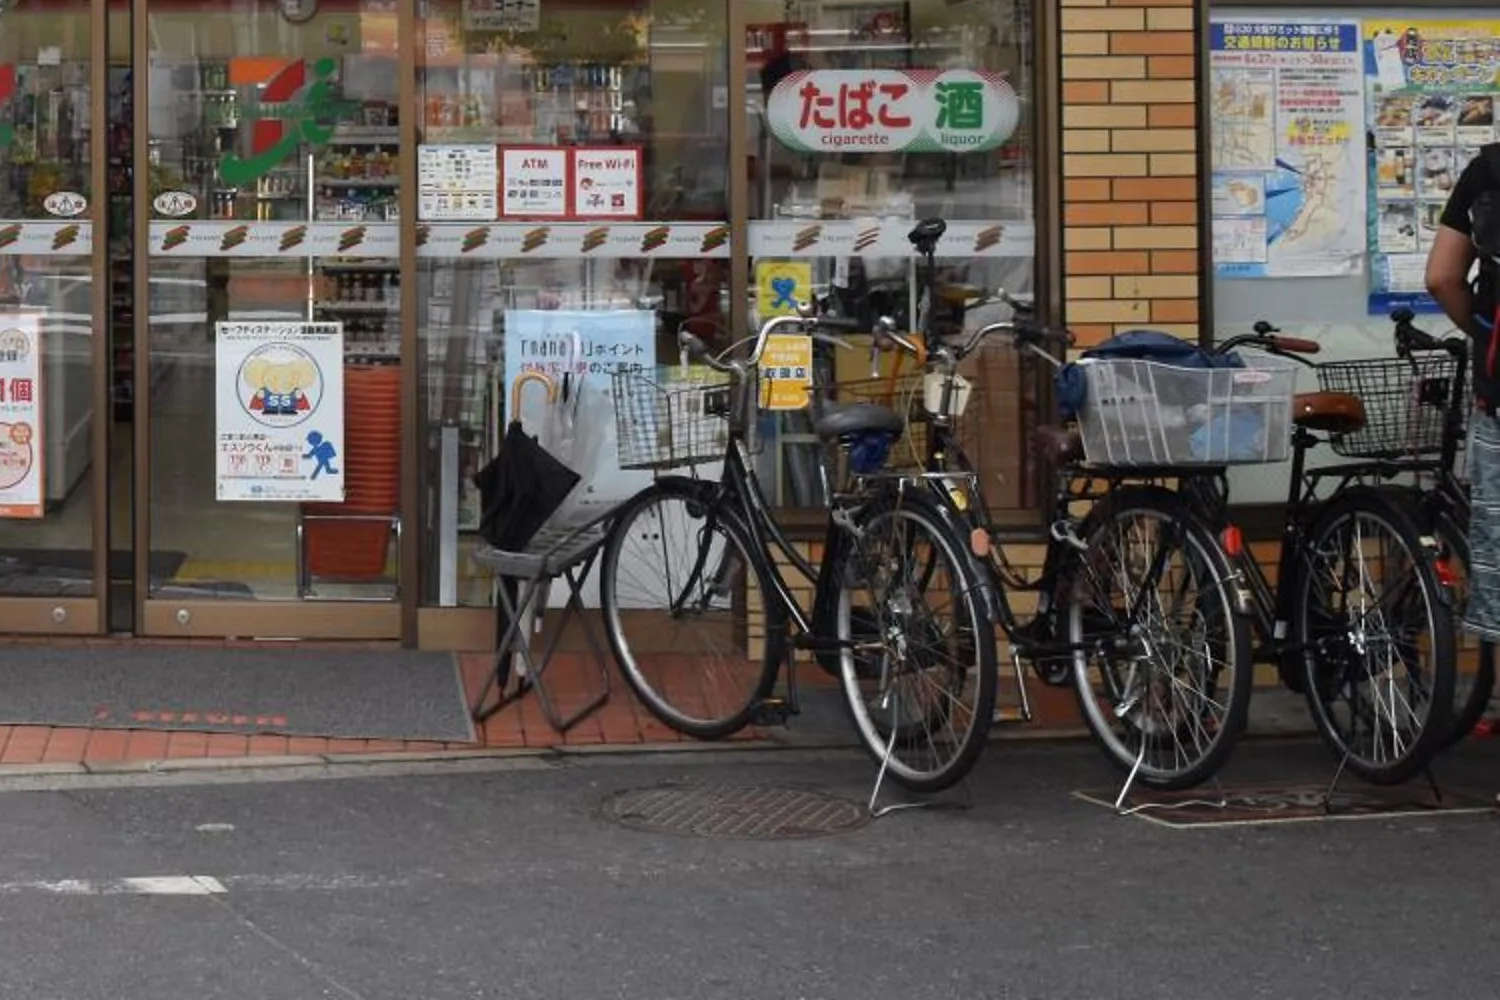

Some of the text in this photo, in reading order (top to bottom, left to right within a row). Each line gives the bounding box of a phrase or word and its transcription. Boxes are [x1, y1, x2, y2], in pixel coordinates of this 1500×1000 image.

[799, 81, 985, 129] たばこ 酒
[821, 132, 985, 146] cigarette liquor
[521, 157, 548, 169] ATM
[578, 158, 635, 169] Free Wi-Fi
